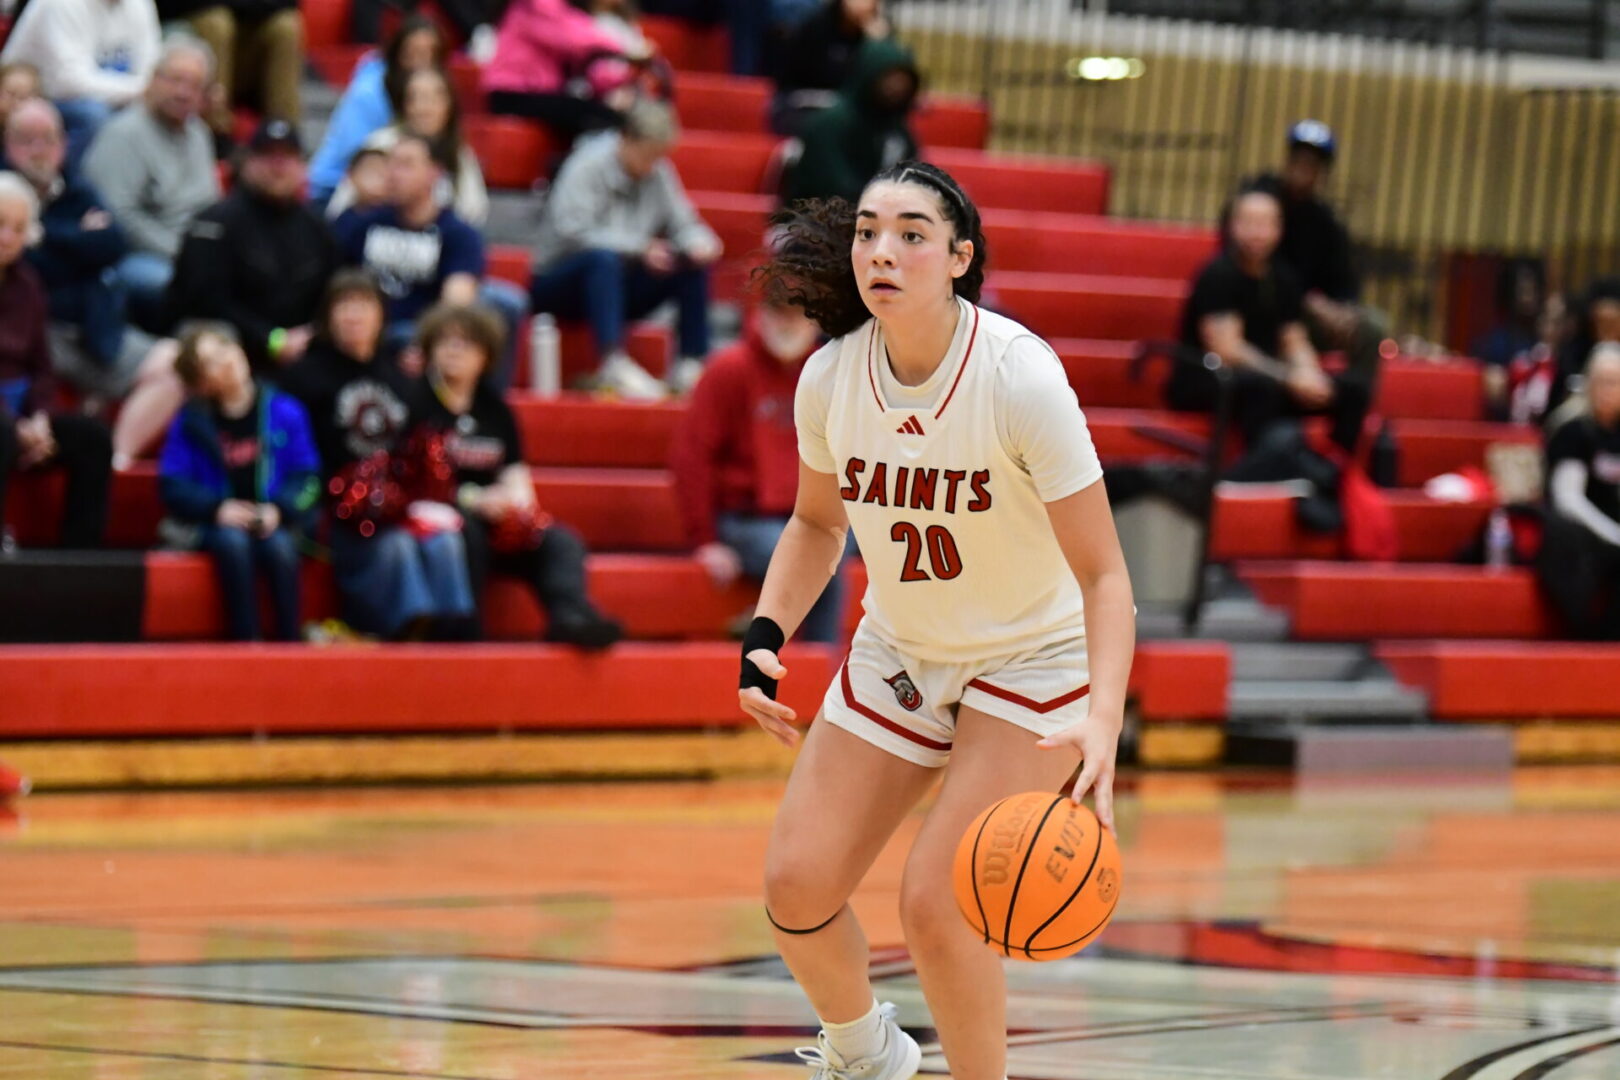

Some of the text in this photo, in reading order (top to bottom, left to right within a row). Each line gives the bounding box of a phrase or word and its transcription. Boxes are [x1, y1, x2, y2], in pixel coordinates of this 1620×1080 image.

[840, 457, 992, 514] SAINTS
[891, 521, 963, 582] 20
[982, 796, 1040, 886] Wilson
